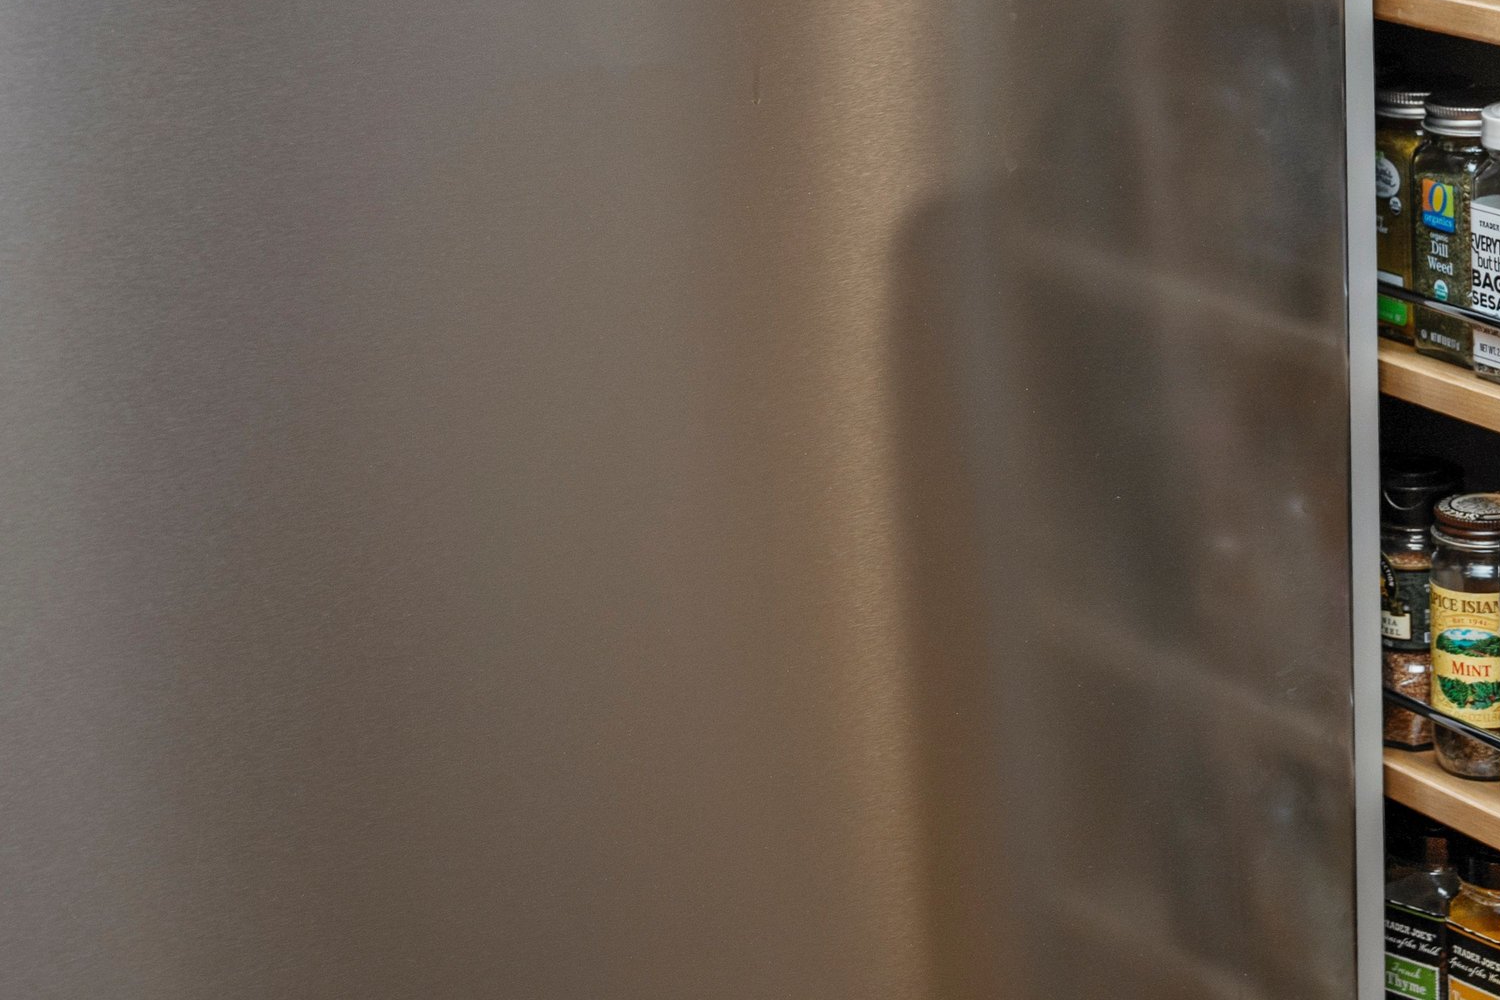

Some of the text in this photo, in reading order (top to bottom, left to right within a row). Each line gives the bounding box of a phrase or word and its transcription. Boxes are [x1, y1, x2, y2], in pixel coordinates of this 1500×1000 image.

[1431, 241, 1448, 258] Dill
[1427, 255, 1453, 276] Weed
[1478, 254, 1493, 271] but
[1452, 661, 1492, 677] MINT
[1452, 945, 1480, 964] TRADER
[1386, 971, 1427, 996] Thyme
